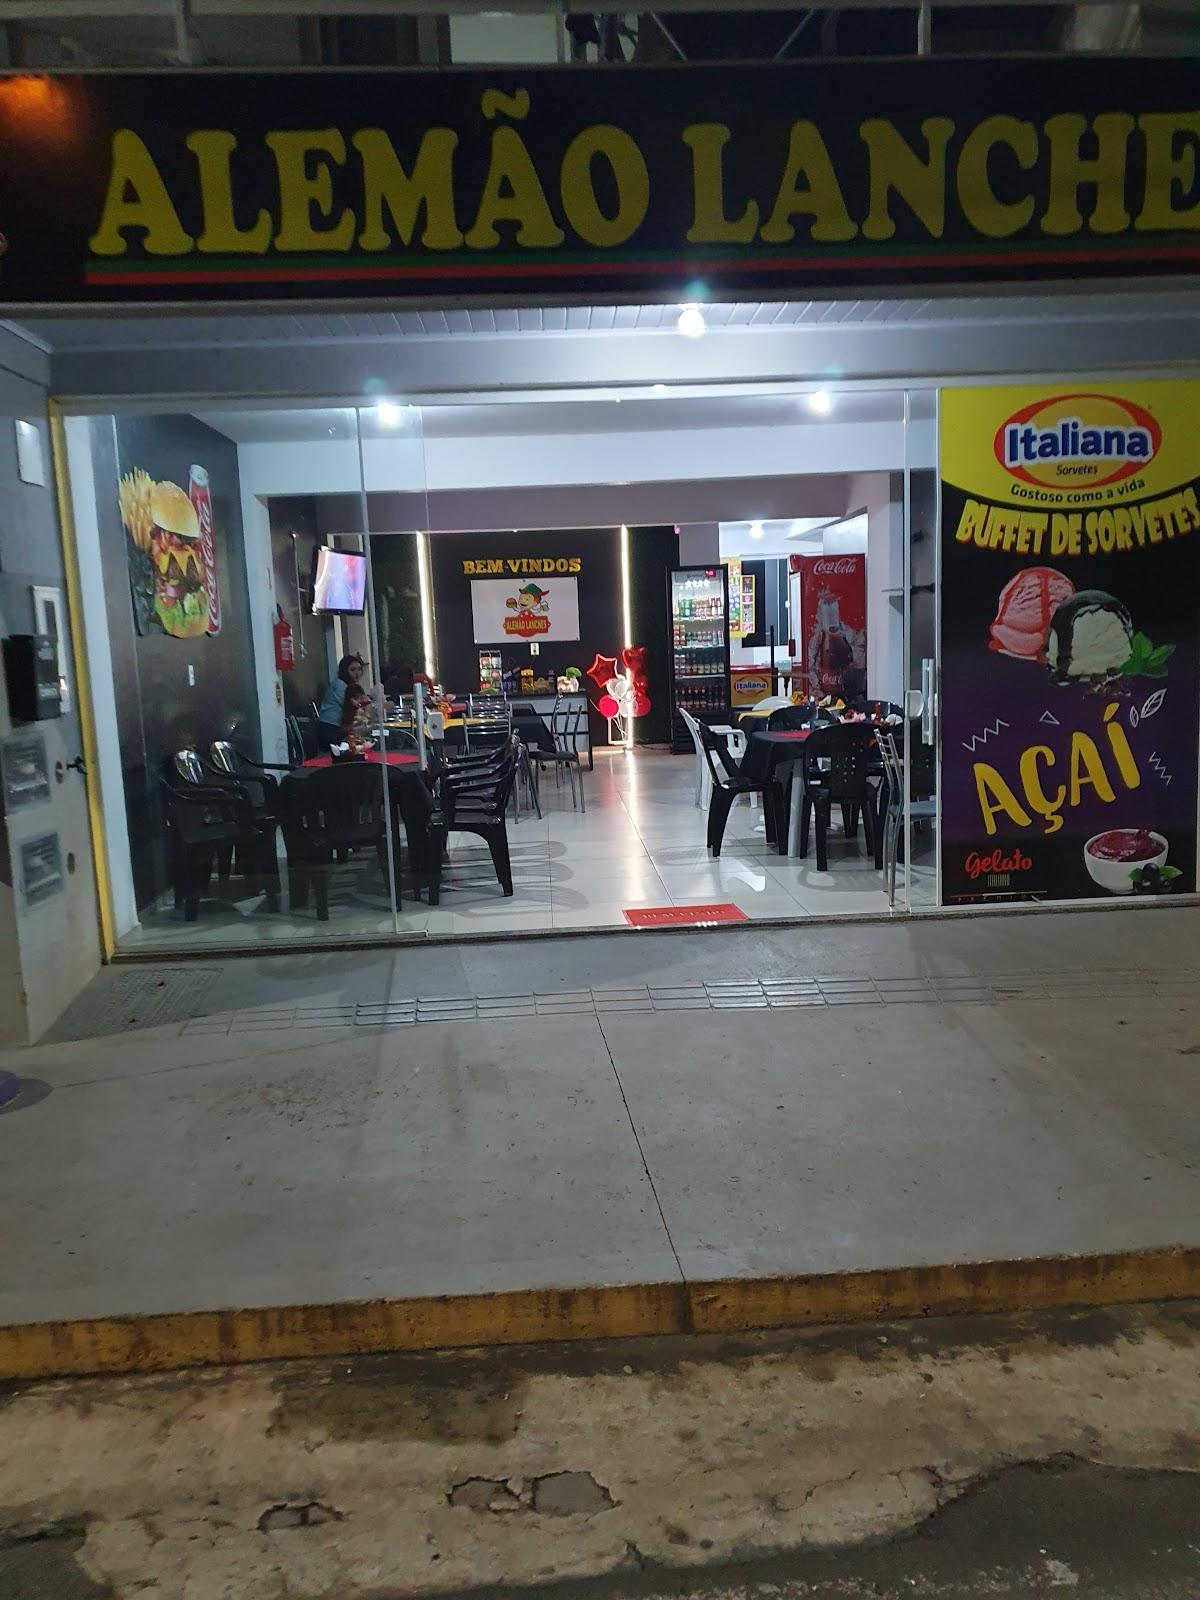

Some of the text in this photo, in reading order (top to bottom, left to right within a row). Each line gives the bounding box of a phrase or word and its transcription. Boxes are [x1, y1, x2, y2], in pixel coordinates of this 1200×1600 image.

[88, 87, 1200, 256] ALEMÃO LANCHE
[1008, 421, 1150, 462] Italiana
[1056, 463, 1098, 476] Sorvetes
[1010, 478, 1146, 503] Gostoso como a vida
[955, 486, 1200, 556] BUFFET DE SORVETES
[463, 558, 582, 575] BEM VINDOS
[736, 680, 767, 690] Italiana
[973, 702, 1142, 836] AÇAÍ
